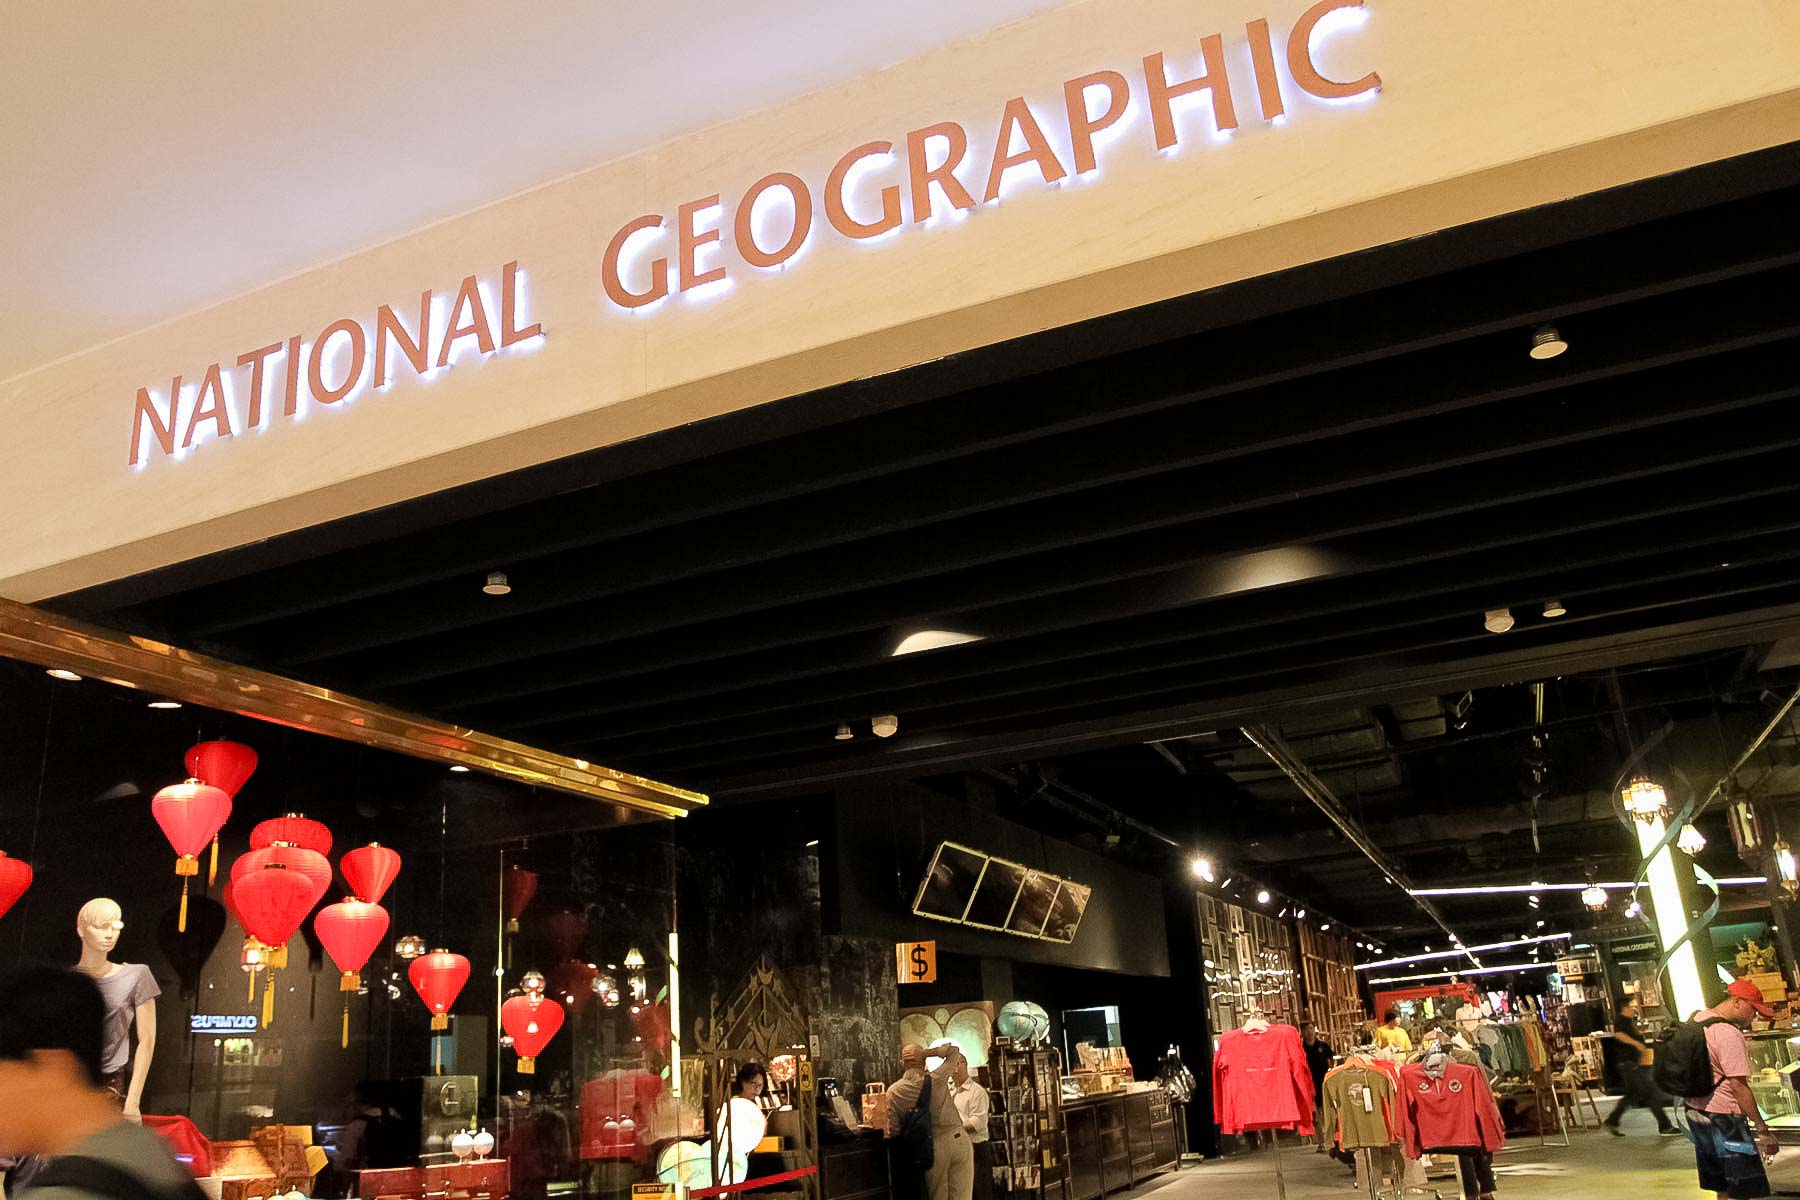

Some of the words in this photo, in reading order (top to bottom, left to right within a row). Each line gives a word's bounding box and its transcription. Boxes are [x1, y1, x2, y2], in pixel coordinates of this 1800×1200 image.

[128, 260, 543, 466] NATIONAL
[602, 0, 1382, 309] GEOGRAPHIC
[911, 944, 928, 980] $
